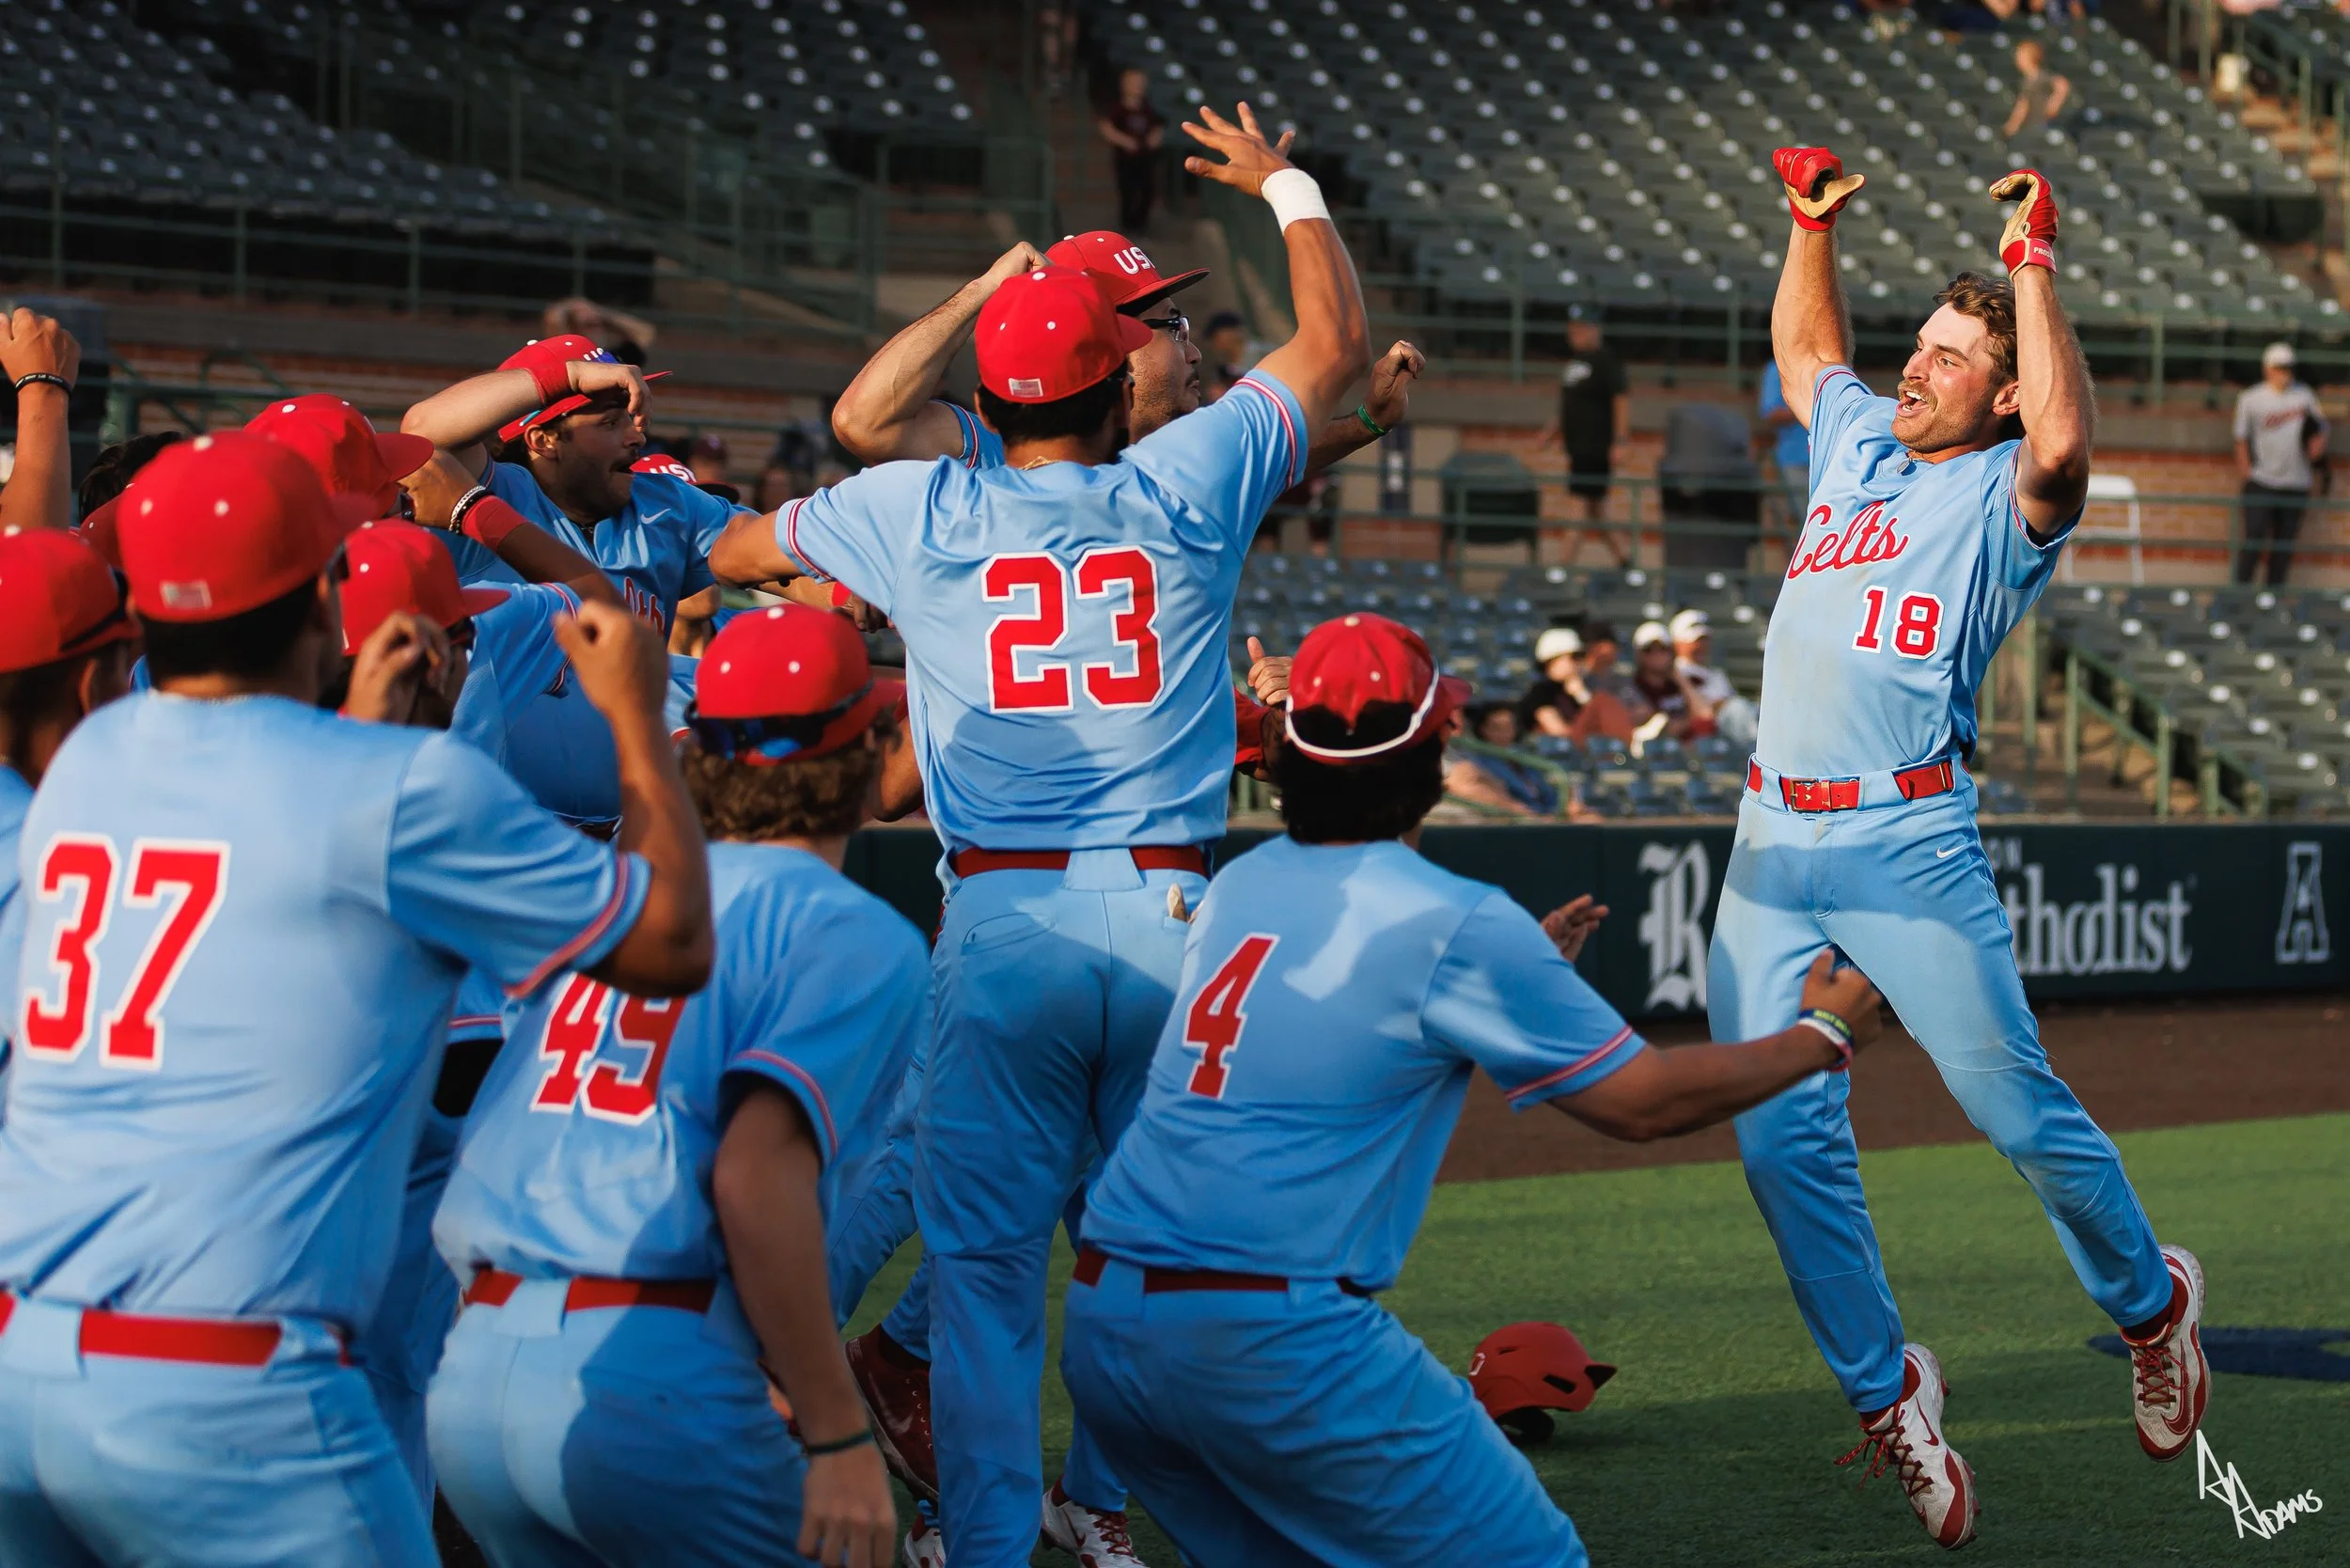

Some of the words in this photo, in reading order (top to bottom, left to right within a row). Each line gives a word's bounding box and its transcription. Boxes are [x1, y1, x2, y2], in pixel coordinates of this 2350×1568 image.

[1113, 246, 1155, 274] US
[1787, 500, 1910, 580] Celts
[980, 545, 1165, 713] 23
[1851, 585, 1944, 660] 18
[23, 831, 231, 1074] 37
[2003, 863, 2193, 976] thodist
[529, 971, 689, 1125] 49
[1182, 933, 1281, 1101] 4
